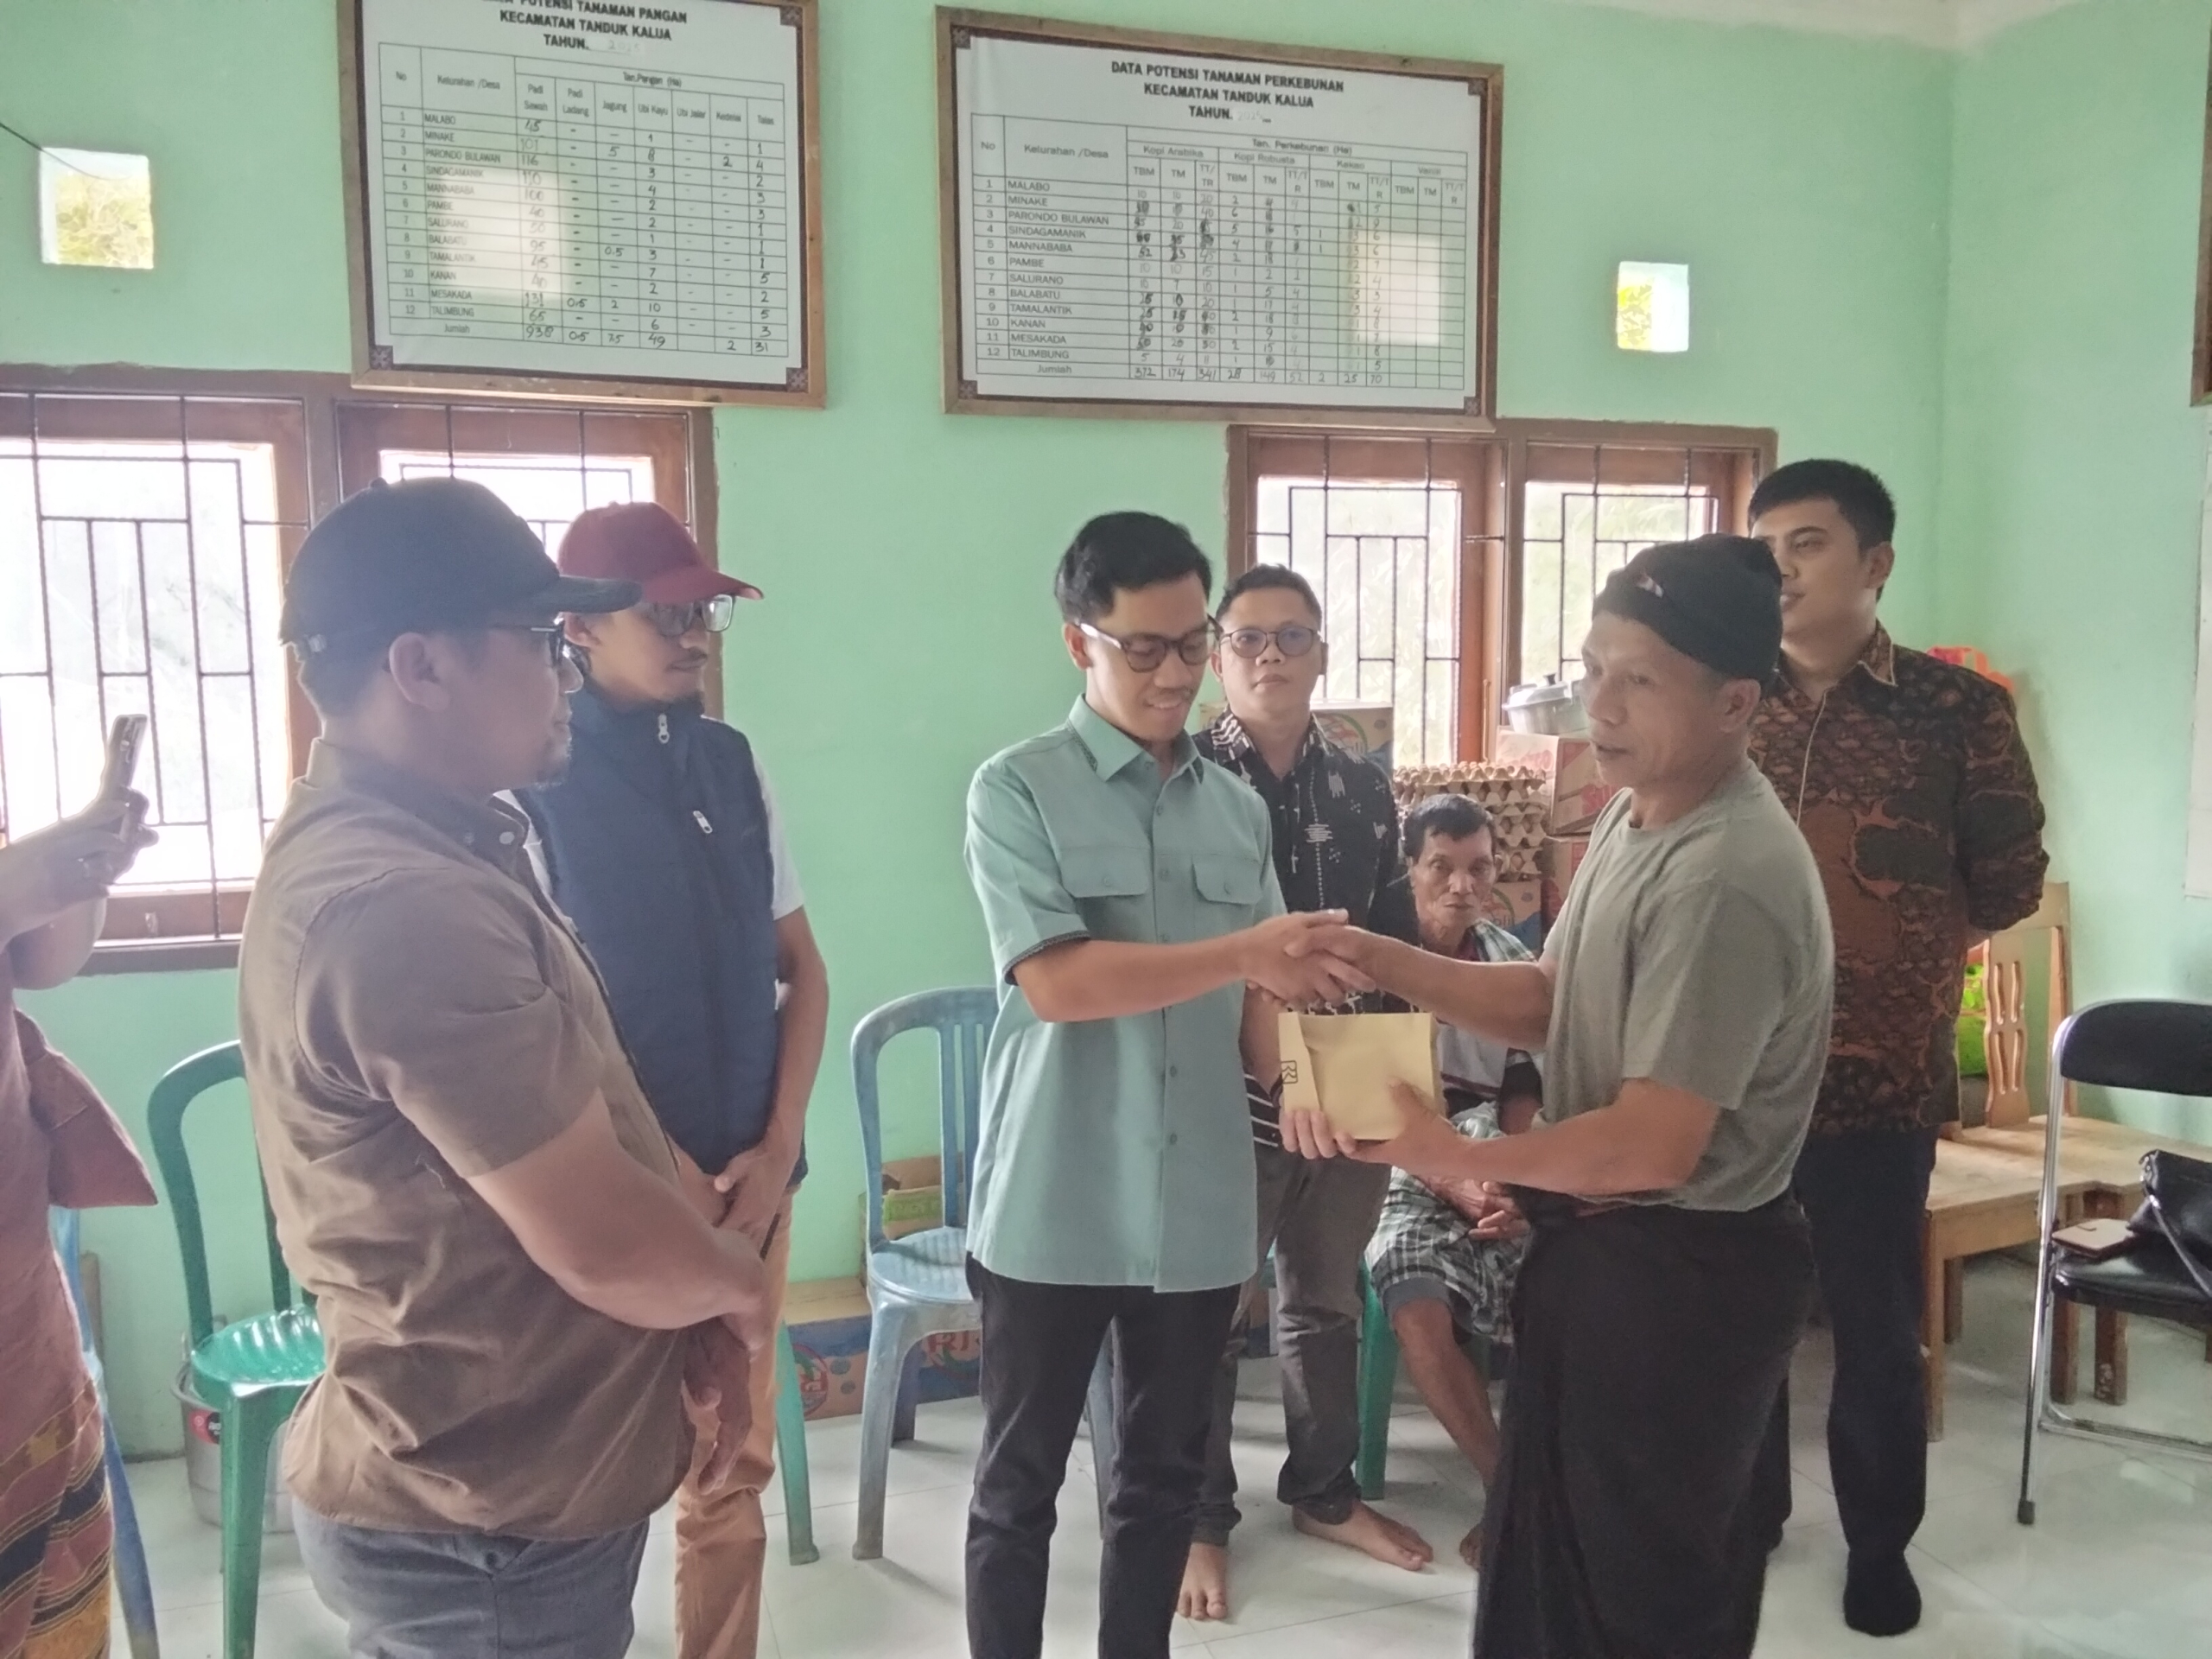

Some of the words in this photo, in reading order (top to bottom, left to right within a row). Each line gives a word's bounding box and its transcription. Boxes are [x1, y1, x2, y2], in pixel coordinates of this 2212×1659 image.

[577, 1, 635, 18] TANAMAN
[639, 8, 687, 23] PANGAN
[500, 10, 575, 29] KECAMATAN
[579, 19, 628, 36] TANDUK
[632, 25, 671, 41] KALUA
[396, 71, 407, 81] No
[437, 75, 474, 86] Kelurahan
[1111, 61, 1142, 75] DATA
[1147, 65, 1198, 79] POTENSI
[1203, 69, 1261, 86] TANAMAN
[1265, 75, 1344, 92] PERKEBUNAN
[528, 84, 543, 94] Padi
[568, 88, 583, 99] Padi
[1144, 83, 1218, 100] KECAMATAN
[1223, 90, 1271, 105] TANDUK
[1275, 93, 1313, 108] KALUA
[524, 100, 548, 111] Sawah
[563, 105, 589, 118] Ladang
[400, 111, 405, 121] 1
[424, 113, 455, 124] MALABO
[400, 129, 406, 138] 2
[425, 131, 454, 143] MINAKE
[981, 141, 995, 150] No
[1024, 144, 1075, 156] Kelurahan
[1274, 140, 1329, 153] Perkebunan
[401, 146, 407, 156] 3
[425, 149, 461, 160] PARONDO
[465, 151, 501, 163] BULAWAN
[1143, 145, 1165, 156] Kopi
[1168, 148, 1204, 158] Arabika
[608, 146, 620, 157] 5
[722, 156, 733, 168] 2
[756, 160, 764, 171] 4
[1234, 152, 1255, 162] Kopi
[1258, 154, 1295, 164] Robusta
[402, 163, 407, 173] 4
[1134, 166, 1154, 176] TBM
[1172, 169, 1185, 178] TM
[756, 175, 765, 188] 2
[1226, 173, 1247, 182] TBM
[1262, 175, 1277, 184] TM
[402, 181, 408, 190] 5
[987, 179, 993, 188] 1
[1008, 181, 1050, 192] MALABO
[1314, 179, 1334, 188] TBM
[1346, 181, 1360, 190] TM
[1395, 185, 1414, 194] TBM
[1424, 188, 1436, 196] TM
[403, 199, 409, 207] 6
[427, 200, 454, 211] PAMBE
[649, 200, 656, 211] 2
[986, 194, 993, 203] 2
[1008, 195, 1048, 207] MINAKE
[404, 216, 409, 225] 7
[649, 217, 656, 227] 2
[987, 210, 993, 219] 3
[1008, 211, 1058, 221] PARONDO
[1062, 214, 1109, 225] BULAWAN
[404, 232, 410, 242] 8
[1008, 226, 1086, 238] SINDAGAMANIK
[988, 239, 994, 248] 5
[1009, 241, 1072, 251] MANNABABA
[404, 250, 410, 259] 9
[1009, 257, 1045, 268] PAMBE
[404, 269, 414, 278] 10
[430, 270, 456, 280] KANAN
[650, 268, 656, 277] 7
[760, 272, 770, 283] 5
[1010, 274, 1064, 284] SALURANO
[404, 288, 414, 297] 11
[431, 289, 472, 300] MESAKADA
[649, 283, 658, 295] 2
[760, 291, 769, 302] 2
[1010, 289, 1060, 299] BALABATU
[405, 305, 416, 315] 12
[431, 306, 474, 317] TALIMBUNG
[611, 300, 619, 308] 2
[649, 302, 661, 312] 10
[760, 309, 770, 319] 5
[988, 302, 995, 311] 9
[1010, 304, 1072, 315] TAMALANTIK
[651, 319, 659, 330] 6
[1011, 319, 1046, 327] KANAN
[444, 324, 470, 334] Jumlah
[987, 333, 999, 341] 11
[1011, 334, 1066, 344] MESAKADA
[727, 340, 736, 351] 2
[988, 347, 1000, 356] 12
[1011, 348, 1069, 359] TALIMBUNG
[1037, 365, 1071, 374] Jumlah
